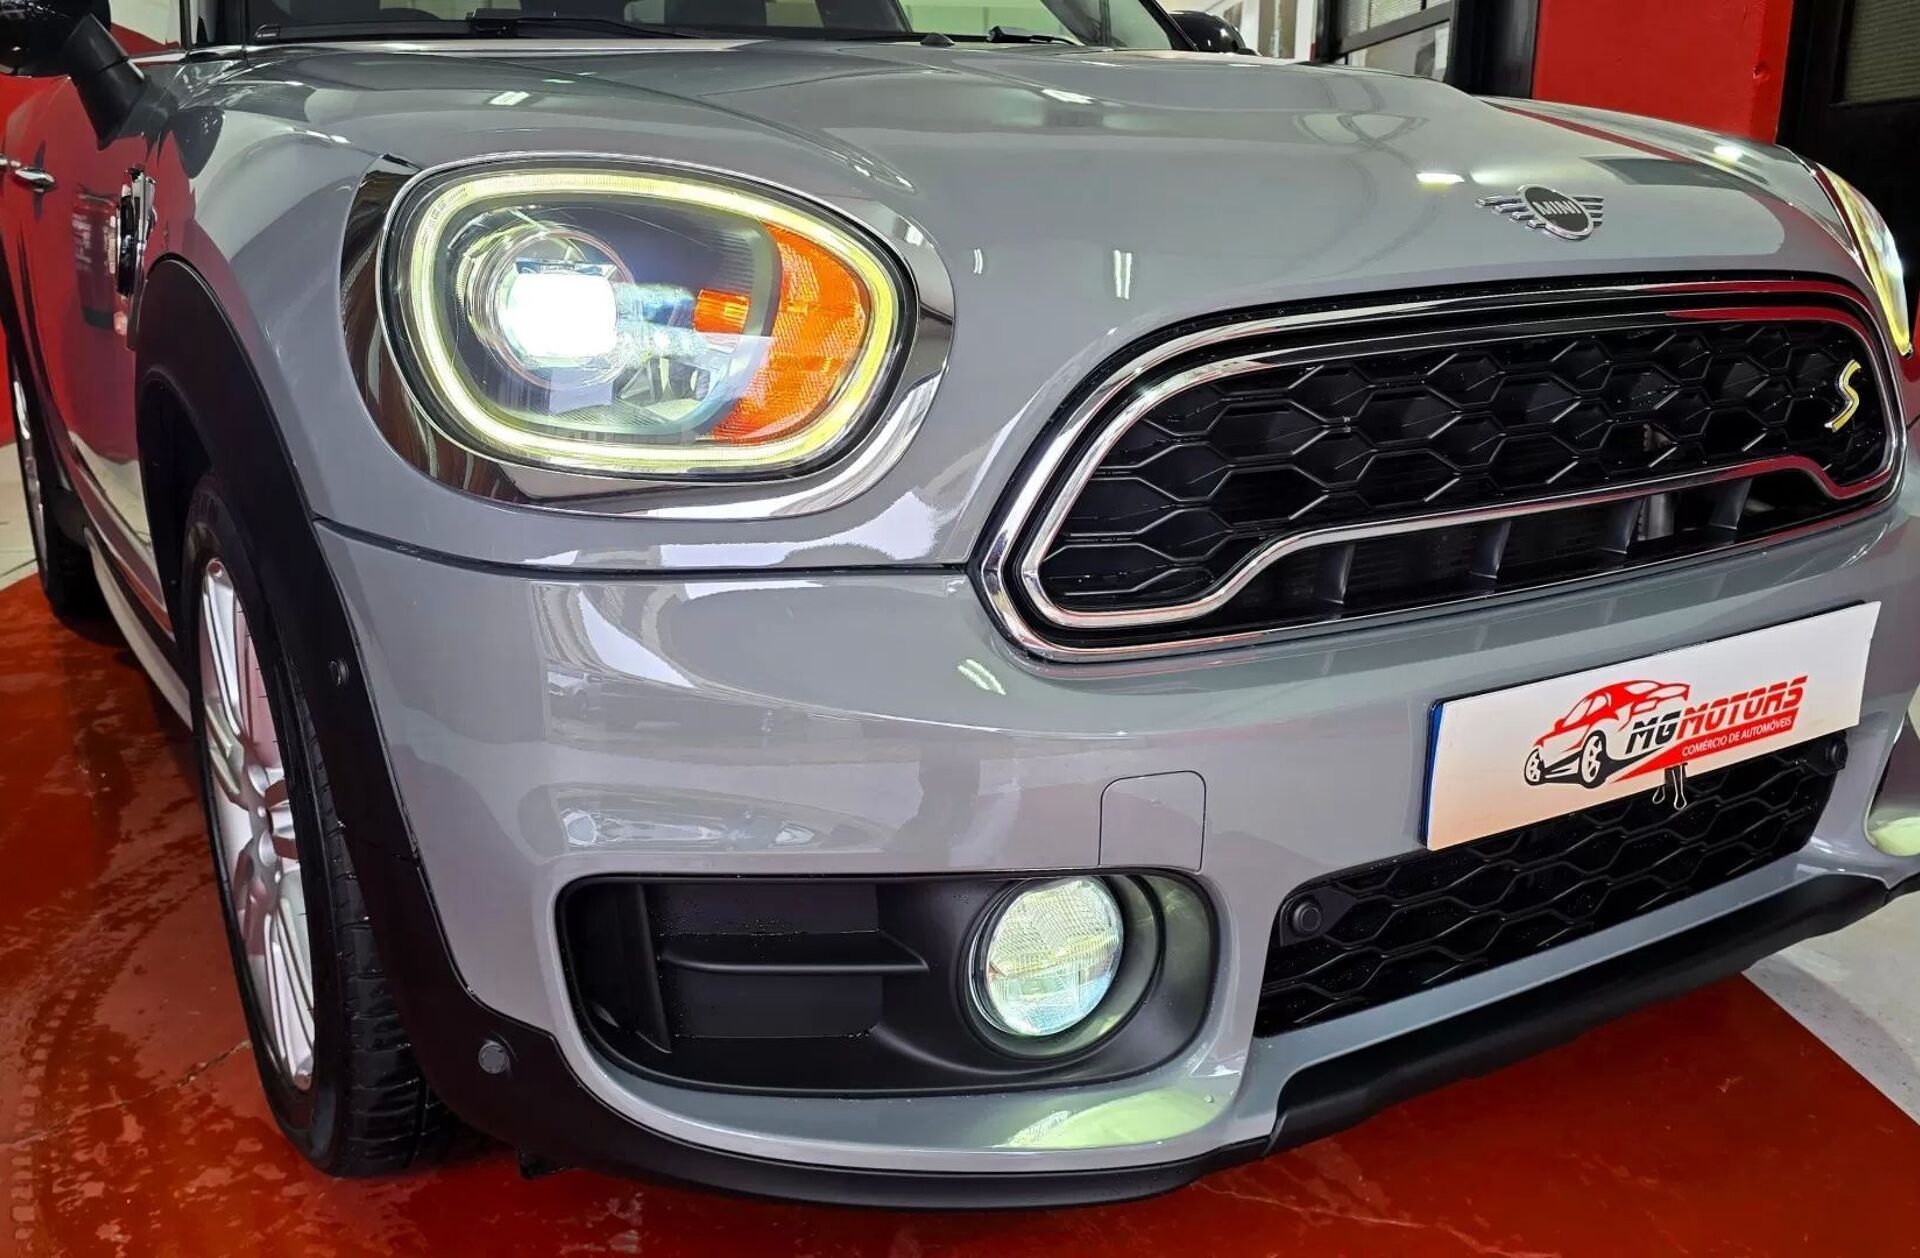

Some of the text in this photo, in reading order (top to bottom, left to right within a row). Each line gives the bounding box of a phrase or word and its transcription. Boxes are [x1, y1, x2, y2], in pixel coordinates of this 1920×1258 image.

[1532, 200, 1581, 215] MINI
[1824, 359, 1861, 433] S
[1682, 715, 1792, 757] COMÉRCIO DE AUTOMÓVEIS
